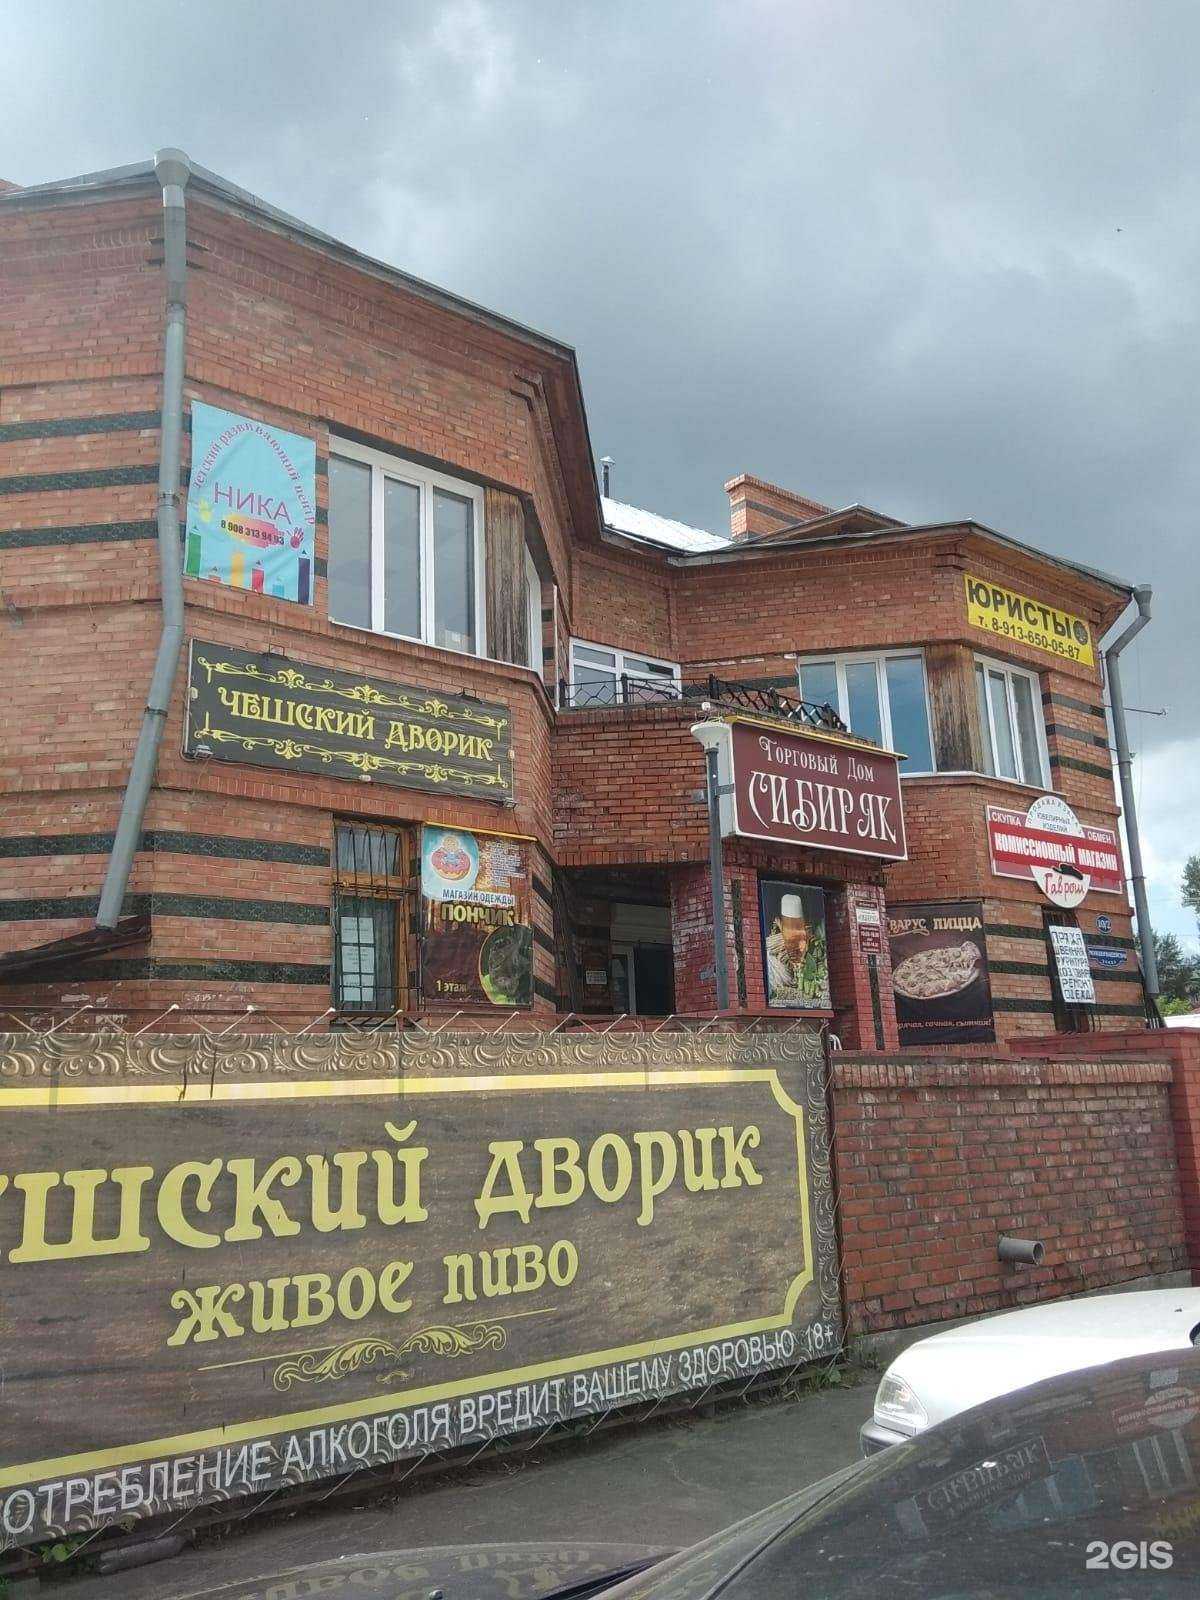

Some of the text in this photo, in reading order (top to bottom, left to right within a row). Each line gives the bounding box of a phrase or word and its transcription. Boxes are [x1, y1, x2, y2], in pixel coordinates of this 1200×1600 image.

[214, 482, 292, 525] НИКА
[220, 519, 227, 529] 8
[227, 521, 244, 535] 908
[967, 579, 1072, 640] ЮРИСТЫ
[992, 617, 1080, 660] 8-913-650-05-87
[217, 686, 494, 762] ЧЕШСКИЙ ДВОРИК
[749, 771, 897, 844] СИБИРЯК
[991, 812, 1022, 827] СКУПКА
[994, 832, 1118, 871] КОМИССИОННЫЙ МАГАЗИН
[1087, 831, 1111, 844] ОБМЕН
[441, 903, 515, 927] ПОНЧИК
[442, 888, 514, 906] МАГАЗИН ОДЕЖДЫ
[933, 917, 983, 932] ПИЦЦА
[436, 980, 442, 992] 1
[0, 1120, 429, 1264] шский
[167, 1240, 579, 1347] живое пиво
[281, 1401, 452, 1476] АЛКОГОЛЯ
[459, 1380, 565, 1434] ВРЕДИТ
[573, 1356, 673, 1407] ВАШЕМУ
[678, 1330, 794, 1385] ЗДОРОВЬЮ
[804, 1323, 834, 1352] 18+
